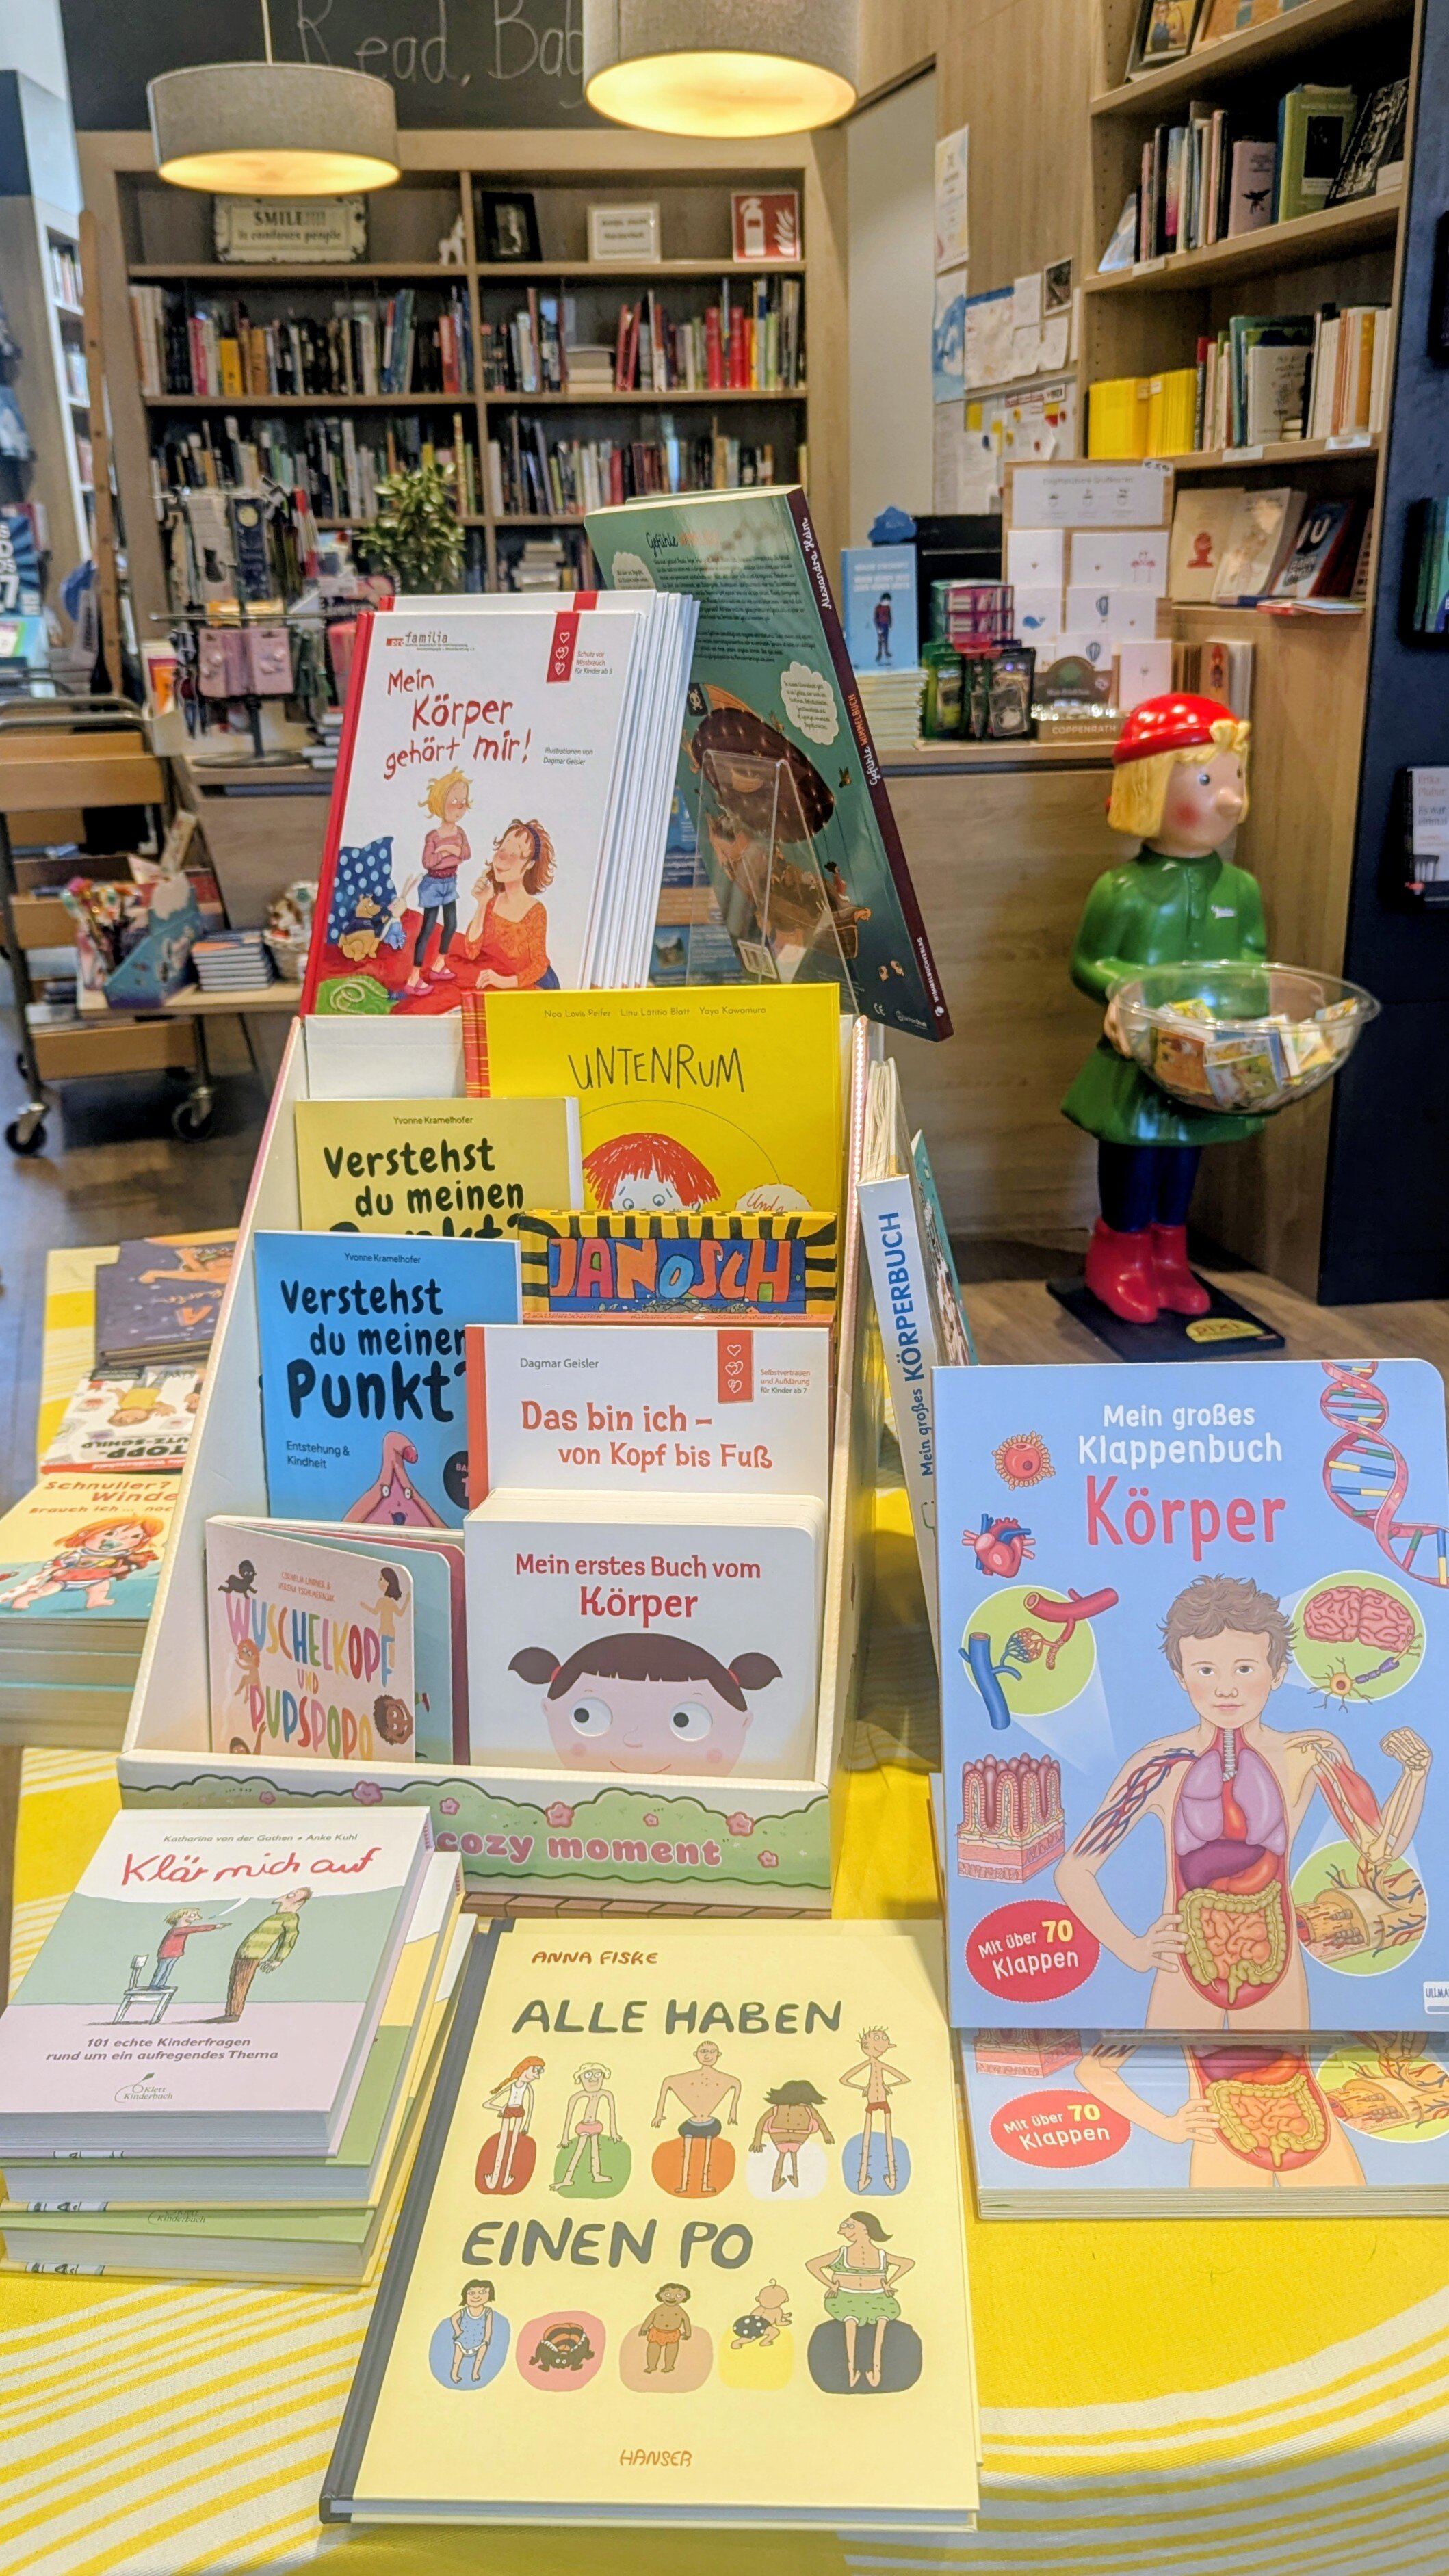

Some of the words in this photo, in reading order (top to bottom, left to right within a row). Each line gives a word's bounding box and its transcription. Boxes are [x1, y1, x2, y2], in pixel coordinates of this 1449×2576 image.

[487, 0, 584, 108] Bab
[646, 532, 679, 557] Gefühle
[801, 517, 818, 552] Helm
[811, 550, 832, 610] Alexandra
[405, 631, 448, 644] familia
[387, 668, 435, 696] Mein
[412, 694, 513, 739] Körper
[848, 694, 869, 746] WIMMELBUCH
[1052, 725, 1117, 735] COPPENRATH
[384, 737, 460, 781] gehört
[473, 729, 532, 764] mir!
[543, 757, 565, 766] Dagmar
[545, 747, 582, 755] Illustrationen
[861, 746, 879, 786] Gefühle
[544, 1010, 562, 1018] Noa
[564, 1010, 585, 1018] Lovis
[588, 1009, 611, 1018] Peifer
[670, 1007, 690, 1016] Blatt
[699, 1006, 720, 1016] Yayo
[722, 1006, 766, 1014] Kawamura
[568, 1044, 745, 1093] UNTENRUM
[424, 1116, 473, 1125] Kramelhofer
[324, 1138, 496, 1179] Verstehst
[355, 1185, 393, 1218] du
[407, 1180, 523, 1214] meinen
[345, 1253, 372, 1262] Yvonne
[374, 1254, 421, 1264] Kramelhofer
[549, 1239, 792, 1302] JANOSCH
[280, 1278, 443, 1315] Verstehst
[878, 1211, 925, 1383] KÖRPERBUCH
[309, 1322, 345, 1356] du
[520, 1358, 561, 1370] Dagmar
[563, 1358, 599, 1369] Geisler
[774, 1377, 810, 1386] Aufklärung
[521, 1400, 577, 1432] Das
[587, 1402, 634, 1432] bin
[644, 1404, 686, 1432] ich
[911, 1387, 931, 1438] großes
[1104, 1404, 1162, 1428] Mein
[1172, 1404, 1255, 1431] großes
[287, 1441, 341, 1457] Entstehung
[343, 1445, 350, 1456] &
[287, 1456, 327, 1469] Kindheit
[558, 1447, 601, 1467] von
[610, 1441, 666, 1473] Kopf
[675, 1443, 711, 1467] bis
[720, 1443, 772, 1469] Fuß
[921, 1440, 933, 1477] Mein
[1079, 1433, 1282, 1470] Klappenbuch
[44, 1481, 172, 1490] Schnuller?
[29, 1505, 88, 1514] Brauch
[1086, 1475, 1286, 1562] Körper
[515, 1554, 569, 1575] Mein
[575, 1555, 646, 1576] erstes
[650, 1555, 707, 1579] Buch
[712, 1562, 761, 1579] vom
[580, 1586, 699, 1628] Körper
[226, 1592, 395, 1687] WUSCHELKOPF
[296, 1668, 319, 1694] UND
[250, 1685, 374, 1761] PUPSPOPO
[163, 1834, 213, 1843] Katharina
[216, 1835, 234, 1843] von
[236, 1834, 254, 1842] der
[257, 1833, 293, 1842] Gathen
[306, 1833, 332, 1842] Anke
[334, 1833, 358, 1842] Kuhl
[436, 1832, 534, 1864] cozy
[547, 1836, 722, 1867] moment
[121, 1852, 209, 1887] Klär
[213, 1851, 300, 1882] mich
[310, 1846, 382, 1874] auf
[978, 1941, 1004, 1959] Mit
[1006, 1929, 1037, 1951] über
[1041, 1919, 1073, 1943] 70
[531, 1950, 593, 1965] ANNA
[599, 1950, 658, 1965] FISKE
[992, 1949, 1079, 1980] Klappen
[1425, 1986, 1449, 1998] ULLMA
[512, 1999, 648, 2034] ALLE
[664, 1999, 842, 2034] HABEN
[46, 2051, 81, 2062] rund
[84, 2052, 107, 2061] um
[111, 2051, 133, 2061] ein
[137, 2050, 225, 2062] aufregendes
[229, 2049, 278, 2060] Thema
[86, 2038, 109, 2049] 101
[113, 2037, 153, 2048] echte
[156, 2036, 251, 2049] Kinderfragen
[124, 2092, 173, 2101] Kinderbuch
[144, 2086, 166, 2094] Klett
[1003, 2119, 1029, 2135] Mit
[1031, 2110, 1064, 2129] über
[1067, 2104, 1101, 2122] 70
[1018, 2125, 1110, 2151] Klappen
[462, 2218, 657, 2267] EINEN
[681, 2221, 753, 2269] PO
[619, 2449, 692, 2468] HANSER
